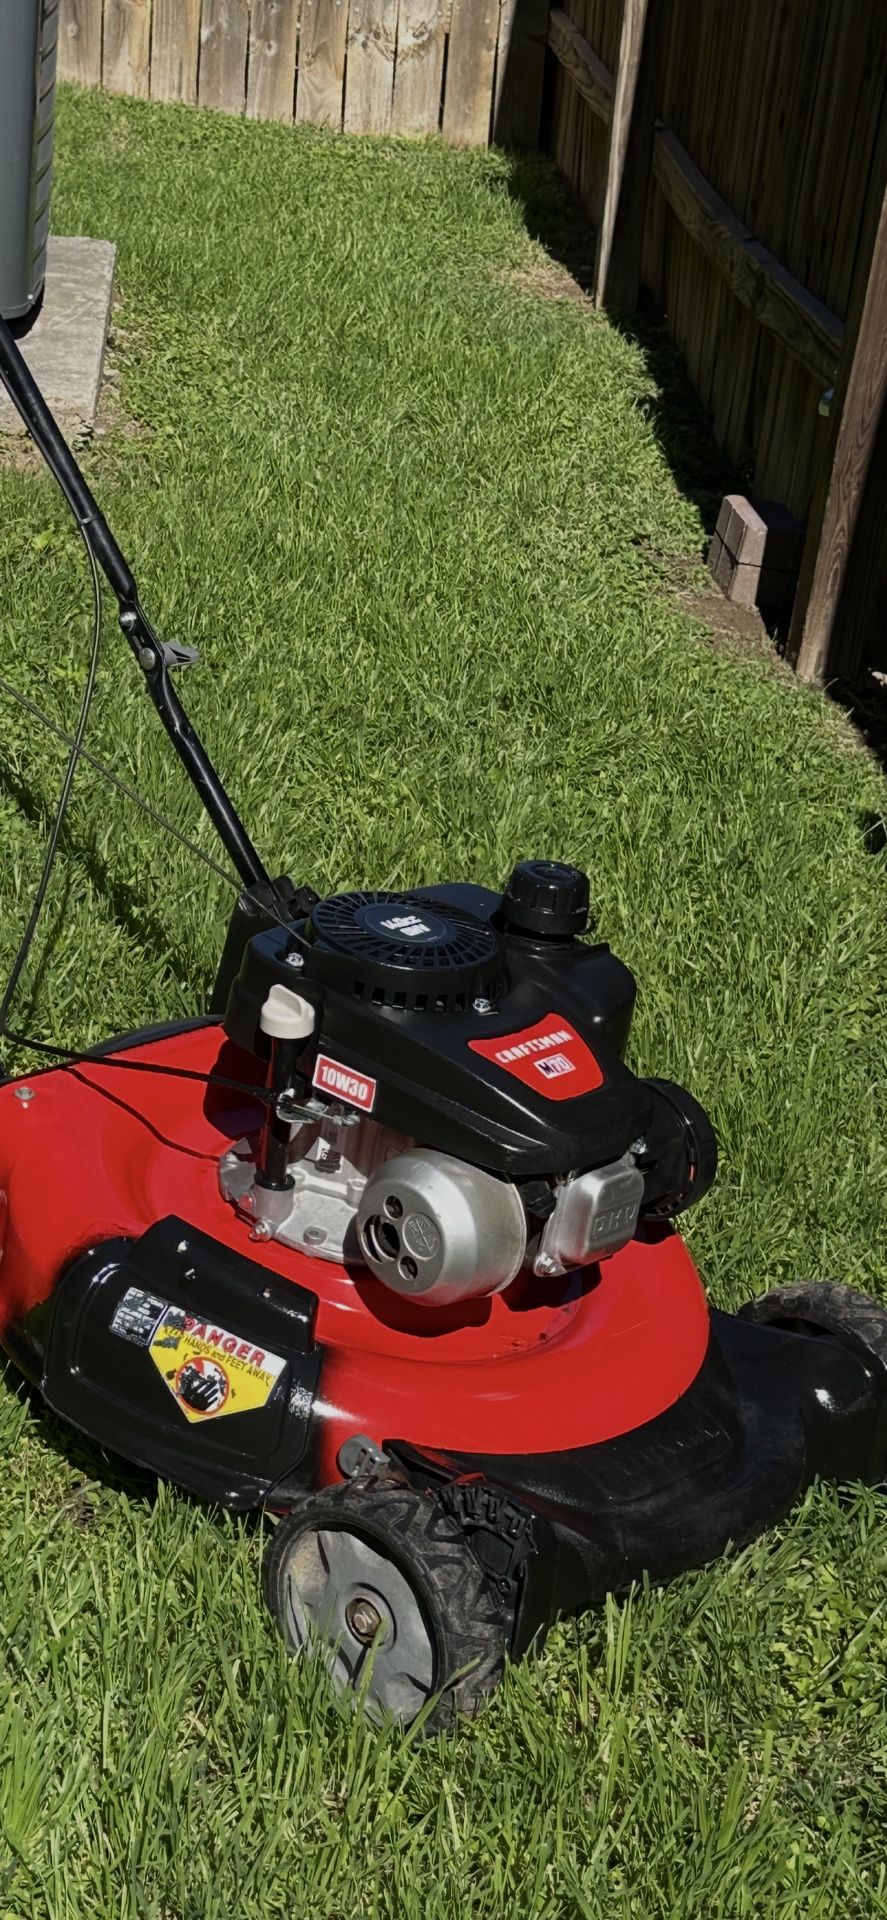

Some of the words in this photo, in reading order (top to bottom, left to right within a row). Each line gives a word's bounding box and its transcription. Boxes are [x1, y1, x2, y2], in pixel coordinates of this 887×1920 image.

[494, 1030, 574, 1064] CRAFTSMAN
[321, 1065, 369, 1101] 10W30
[182, 1315, 266, 1368] DANGER
[184, 1336, 211, 1355] HANDS
[226, 1355, 248, 1371] FEET
